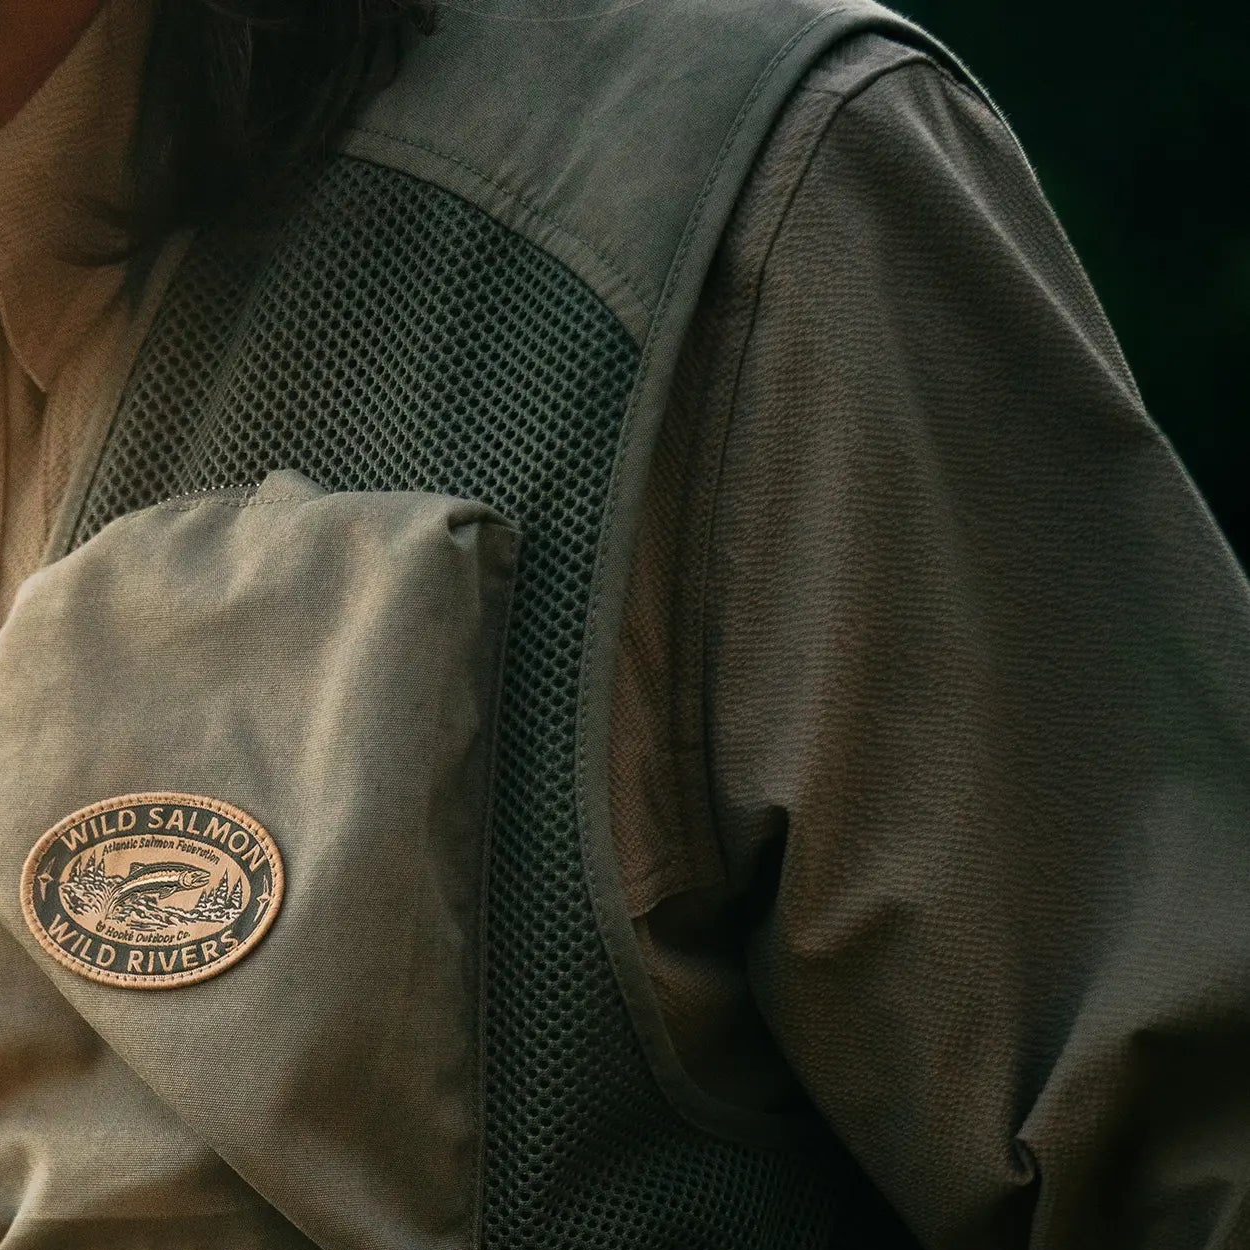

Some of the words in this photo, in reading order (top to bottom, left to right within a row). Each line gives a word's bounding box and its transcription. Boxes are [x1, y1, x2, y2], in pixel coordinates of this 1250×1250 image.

[60, 809, 137, 853] WILD
[148, 807, 267, 874] SALMON
[103, 838, 138, 854] Atlantic
[139, 836, 175, 849] Salmon
[176, 839, 221, 865] Federation
[49, 914, 116, 967] WILD
[127, 929, 241, 974] RIVERS
[135, 932, 175, 943] Outdoor
